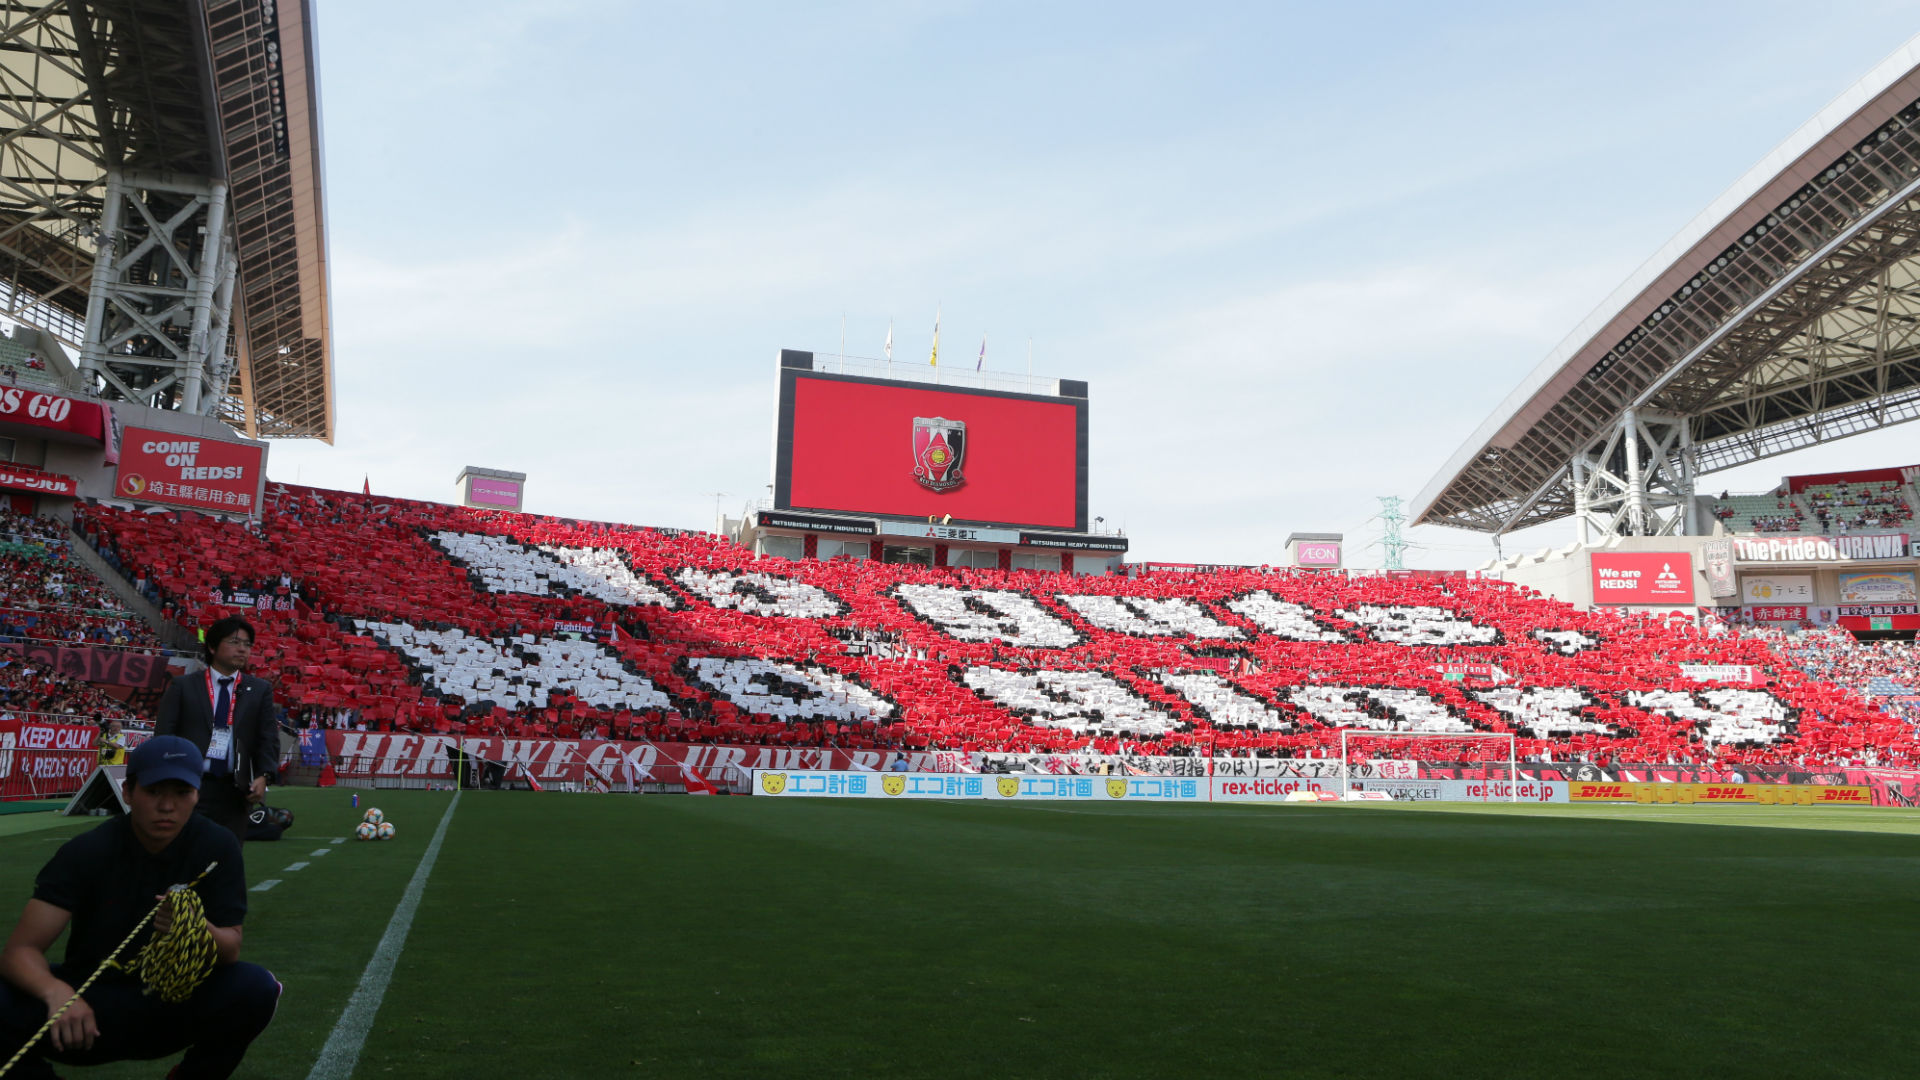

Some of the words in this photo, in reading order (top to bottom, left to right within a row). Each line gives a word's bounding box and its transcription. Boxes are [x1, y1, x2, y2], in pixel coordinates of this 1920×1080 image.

[0, 388, 24, 414] S
[28, 394, 71, 422] GO
[142, 442, 200, 454] COME
[165, 455, 195, 467] ON
[181, 467, 243, 480] REDS!
[148, 481, 251, 506] 埼玉縣信用金庫
[772, 519, 809, 528] MITSUBISHI
[811, 522, 833, 530] HEAVY
[834, 525, 873, 533] INDUSTRIES
[938, 528, 977, 540] 三菱重工
[1734, 539, 1769, 561] The
[1770, 540, 1817, 560] Pride
[1818, 540, 1838, 560] of
[1839, 535, 1903, 559] URAWA
[1599, 568, 1619, 578] We
[1621, 570, 1641, 578] are
[1600, 579, 1638, 589] REDS!
[554, 622, 593, 634] Fighting
[19, 727, 55, 748] KEEP
[56, 729, 91, 749] CALM
[207, 748, 225, 756] 2019
[335, 733, 493, 775] HERE
[494, 739, 580, 778] WE
[789, 775, 867, 794] エコ計画
[908, 777, 984, 796] エコ計画
[1021, 778, 1093, 797] エコ計画
[1129, 780, 1196, 798] エコ計画
[1222, 779, 1322, 795] rex-ticketjp
[1581, 786, 1625, 798] DHL
[1707, 788, 1747, 799] DHL
[1823, 789, 1860, 801] DHL
